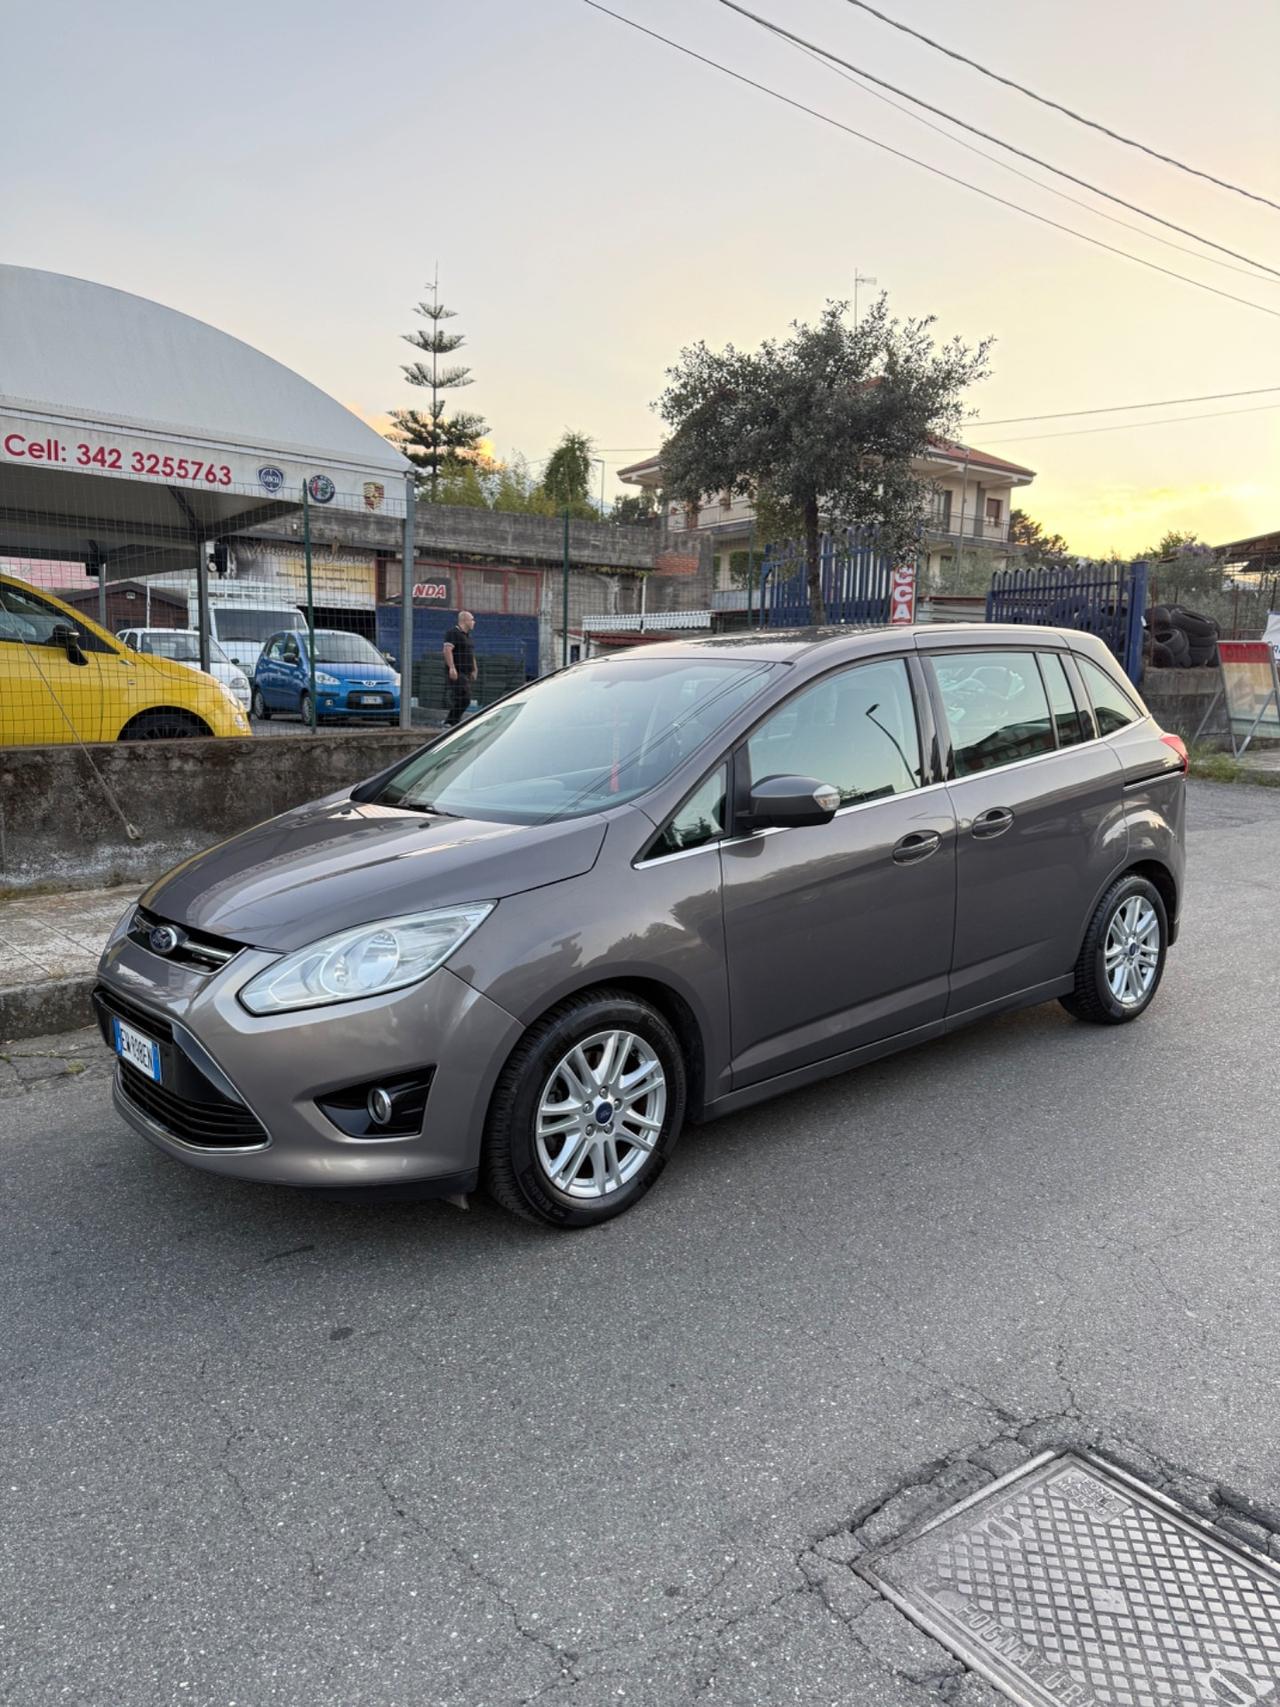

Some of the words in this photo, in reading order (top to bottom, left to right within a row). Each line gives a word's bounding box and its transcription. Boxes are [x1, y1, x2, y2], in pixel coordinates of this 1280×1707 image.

[4, 433, 66, 462] Cell:
[76, 443, 124, 469] 342
[131, 450, 232, 486] 3255763
[412, 583, 446, 599] NDA
[893, 566, 913, 623] CCA
